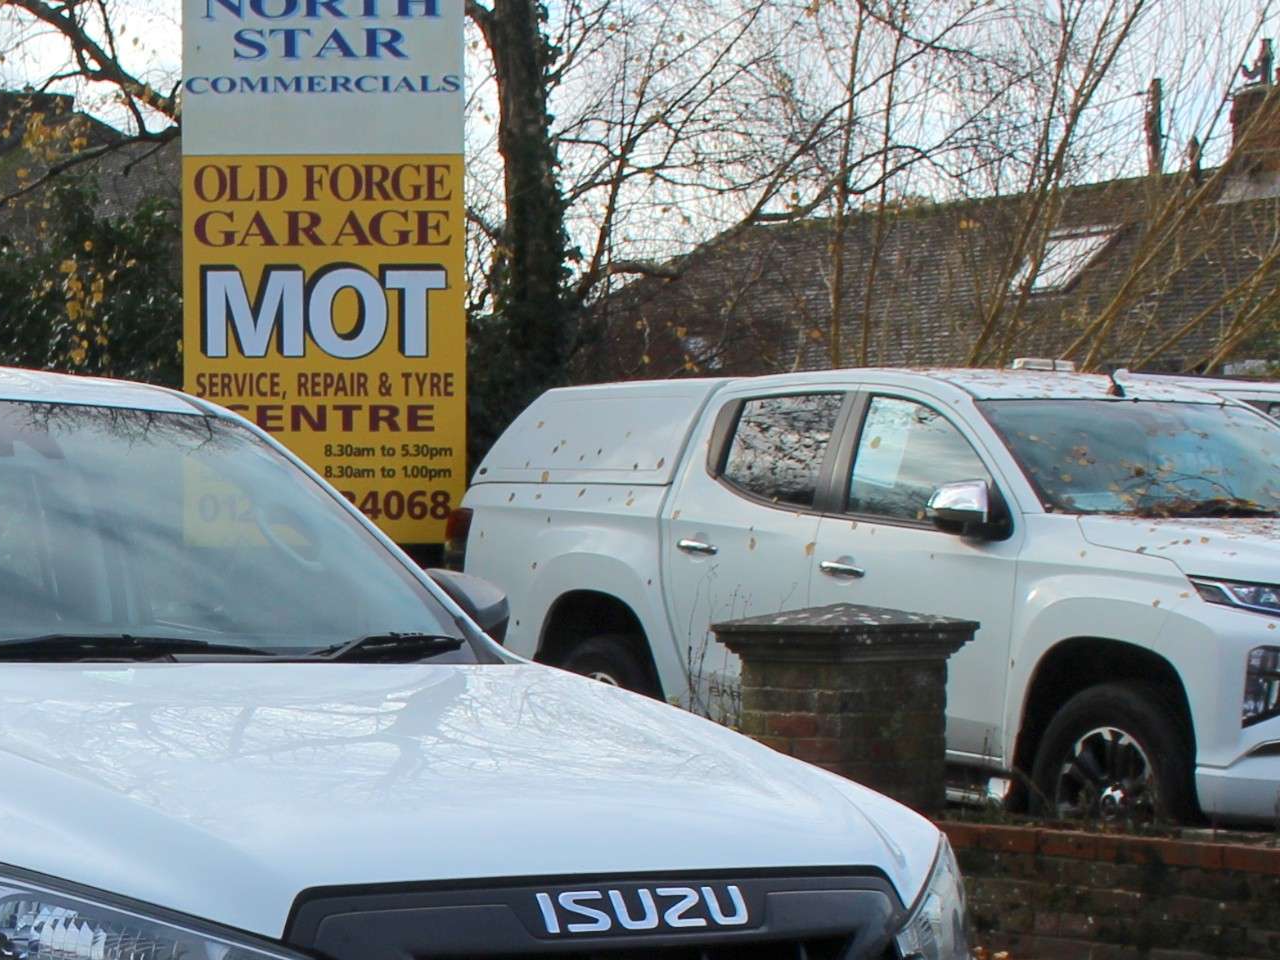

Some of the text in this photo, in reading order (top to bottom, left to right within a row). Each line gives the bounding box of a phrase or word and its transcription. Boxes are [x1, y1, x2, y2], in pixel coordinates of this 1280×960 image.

[201, 0, 442, 20] NORTH
[233, 27, 408, 59] STAR
[185, 74, 461, 94] COMMERCIALS
[193, 163, 453, 203] OLD FORGE
[193, 209, 453, 247] GARAGE
[200, 262, 449, 360] MOT
[195, 372, 455, 400] SERVICE, REPAIR & TYRE
[324, 444, 453, 460] 8.30am to 5.30pm
[324, 465, 452, 481] 8.30am to 1.00pm
[535, 885, 749, 934] ISUZU
